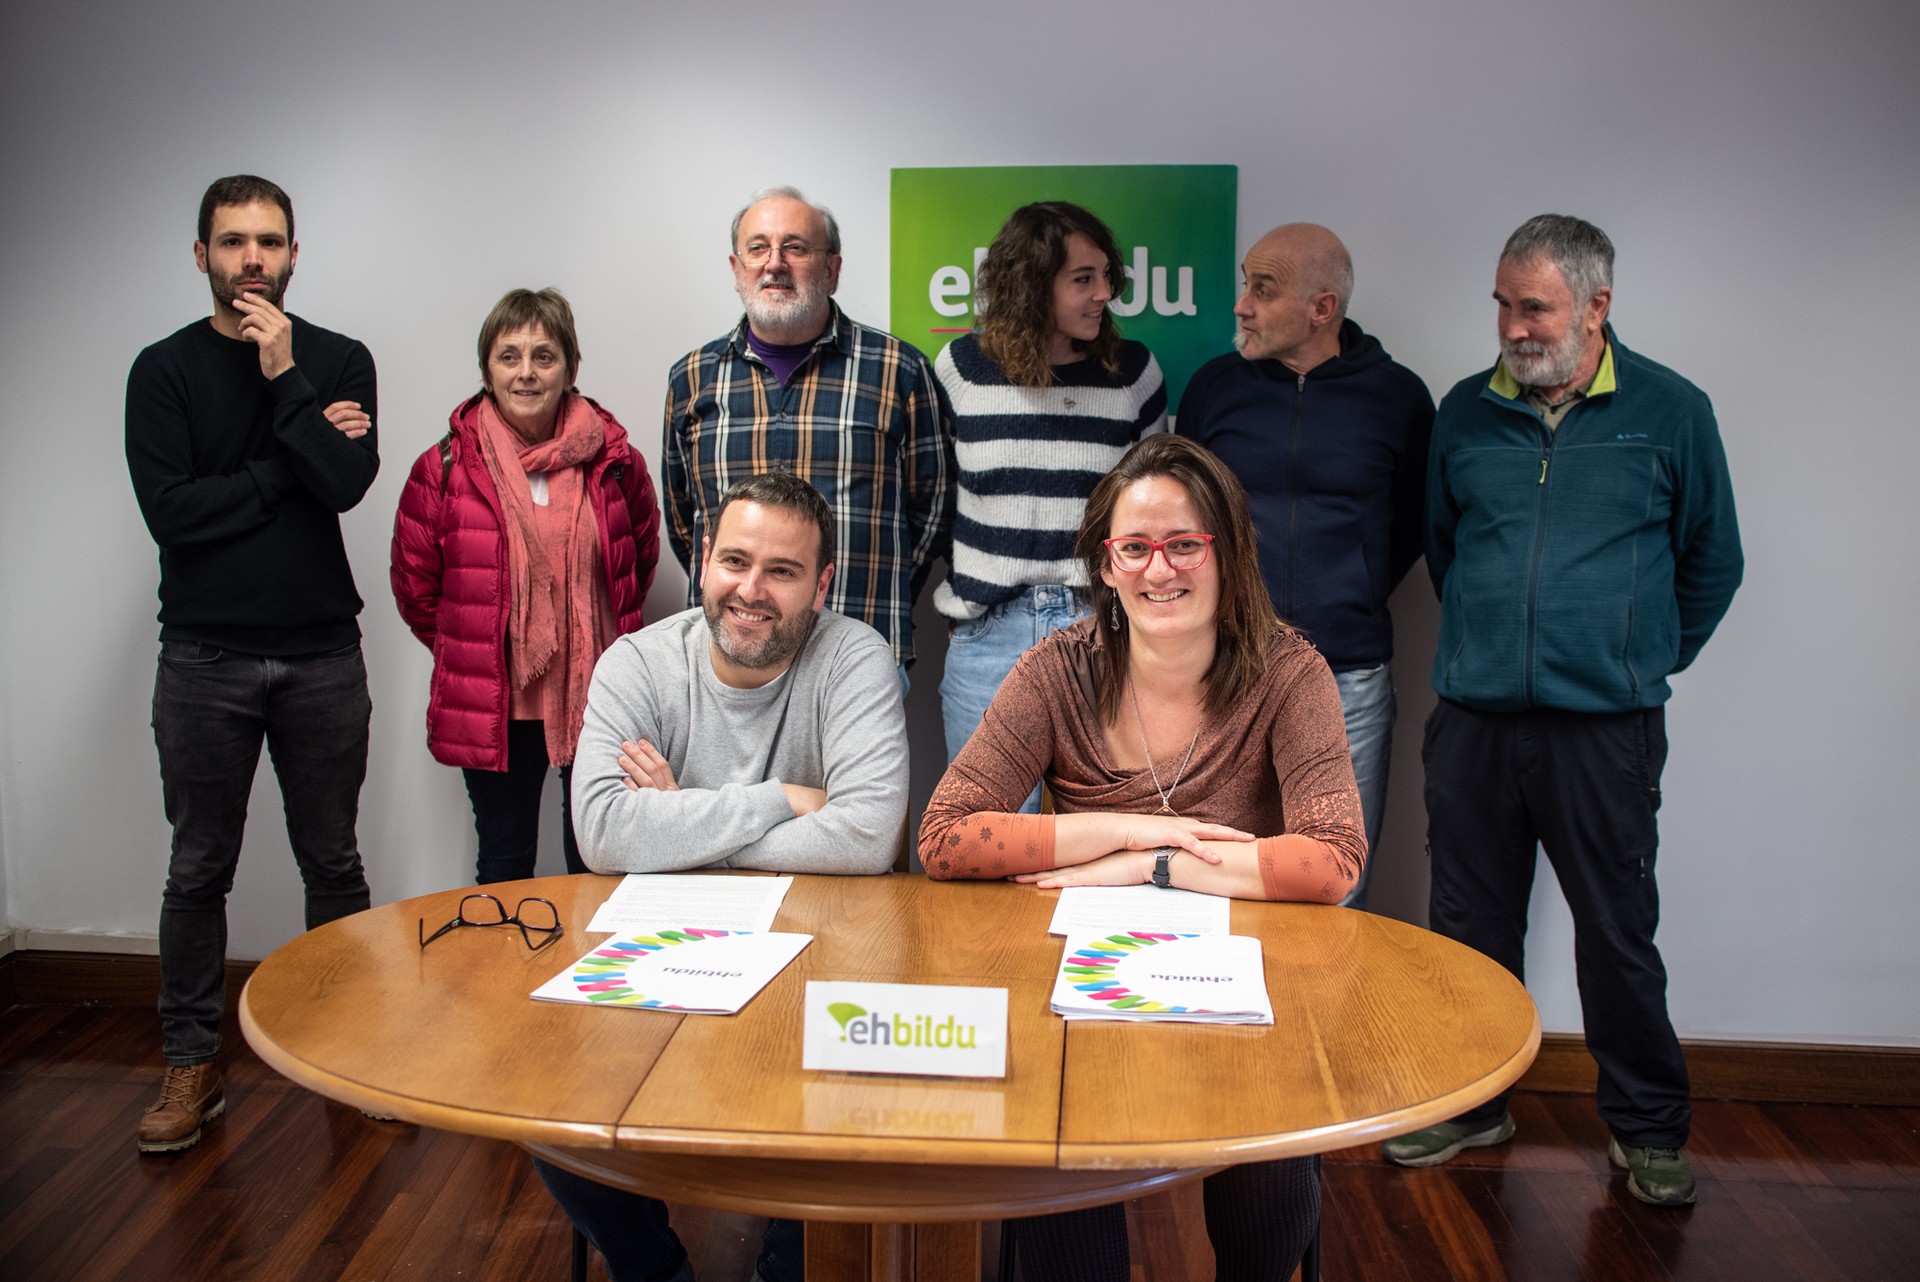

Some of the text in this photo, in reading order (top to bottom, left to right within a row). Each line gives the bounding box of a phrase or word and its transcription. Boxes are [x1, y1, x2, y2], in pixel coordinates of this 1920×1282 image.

[662, 967, 743, 978] ehbildu
[1151, 974, 1234, 983] ehbildu
[849, 1012, 977, 1049] ehbildu
